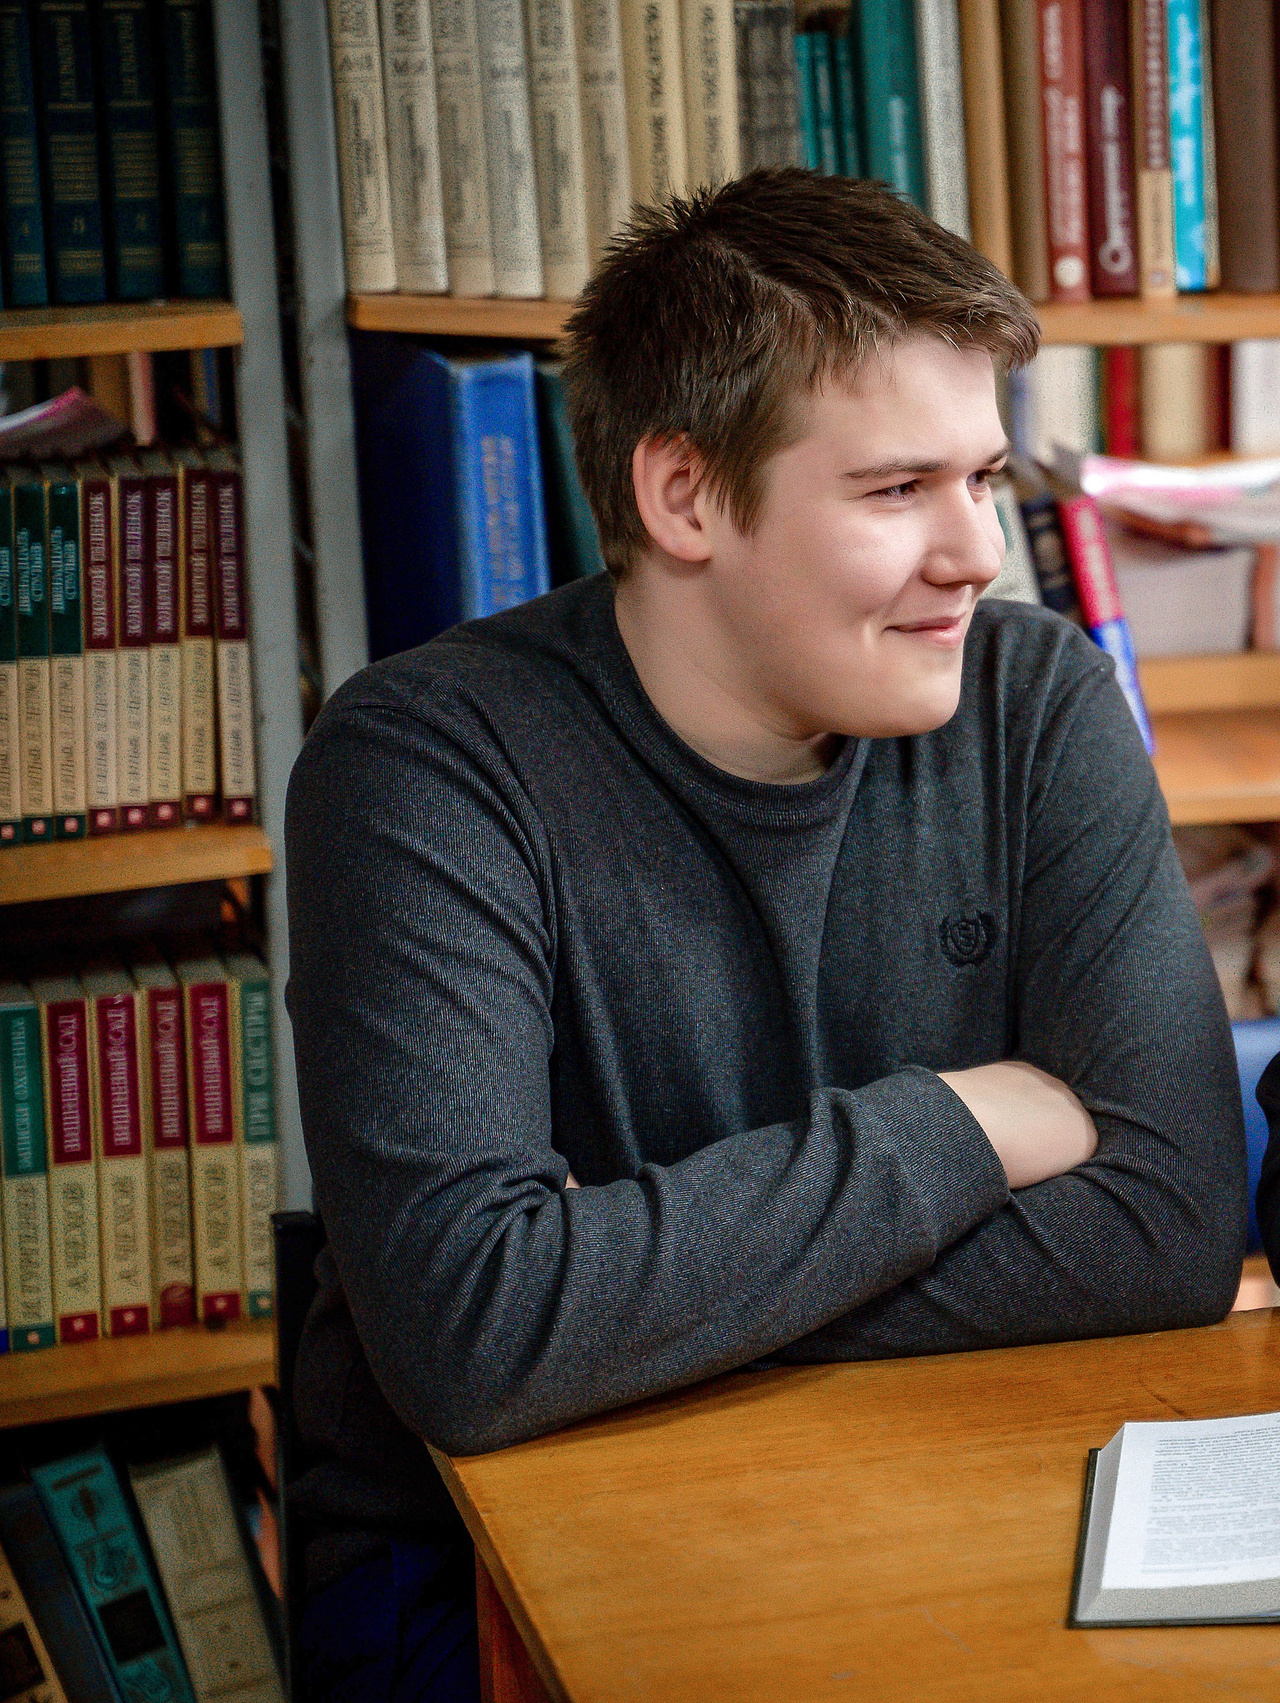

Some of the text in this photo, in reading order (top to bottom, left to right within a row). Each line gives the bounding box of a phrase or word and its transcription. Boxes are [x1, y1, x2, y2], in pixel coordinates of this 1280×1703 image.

[57, 1011, 79, 1052] САД
[107, 1006, 128, 1044] САД
[157, 999, 176, 1035] САД
[200, 995, 220, 1030] САД
[246, 992, 269, 1137] ТРИ СЕСТРЫ
[16, 1183, 39, 1295] ТУРГЕНЕВ
[61, 1182, 86, 1268] ЧЕХОВ
[112, 1176, 136, 1261] ЧЕХОВ
[160, 1161, 185, 1247] ЧЕХОВ
[205, 1163, 228, 1248] ЧЕХОВ
